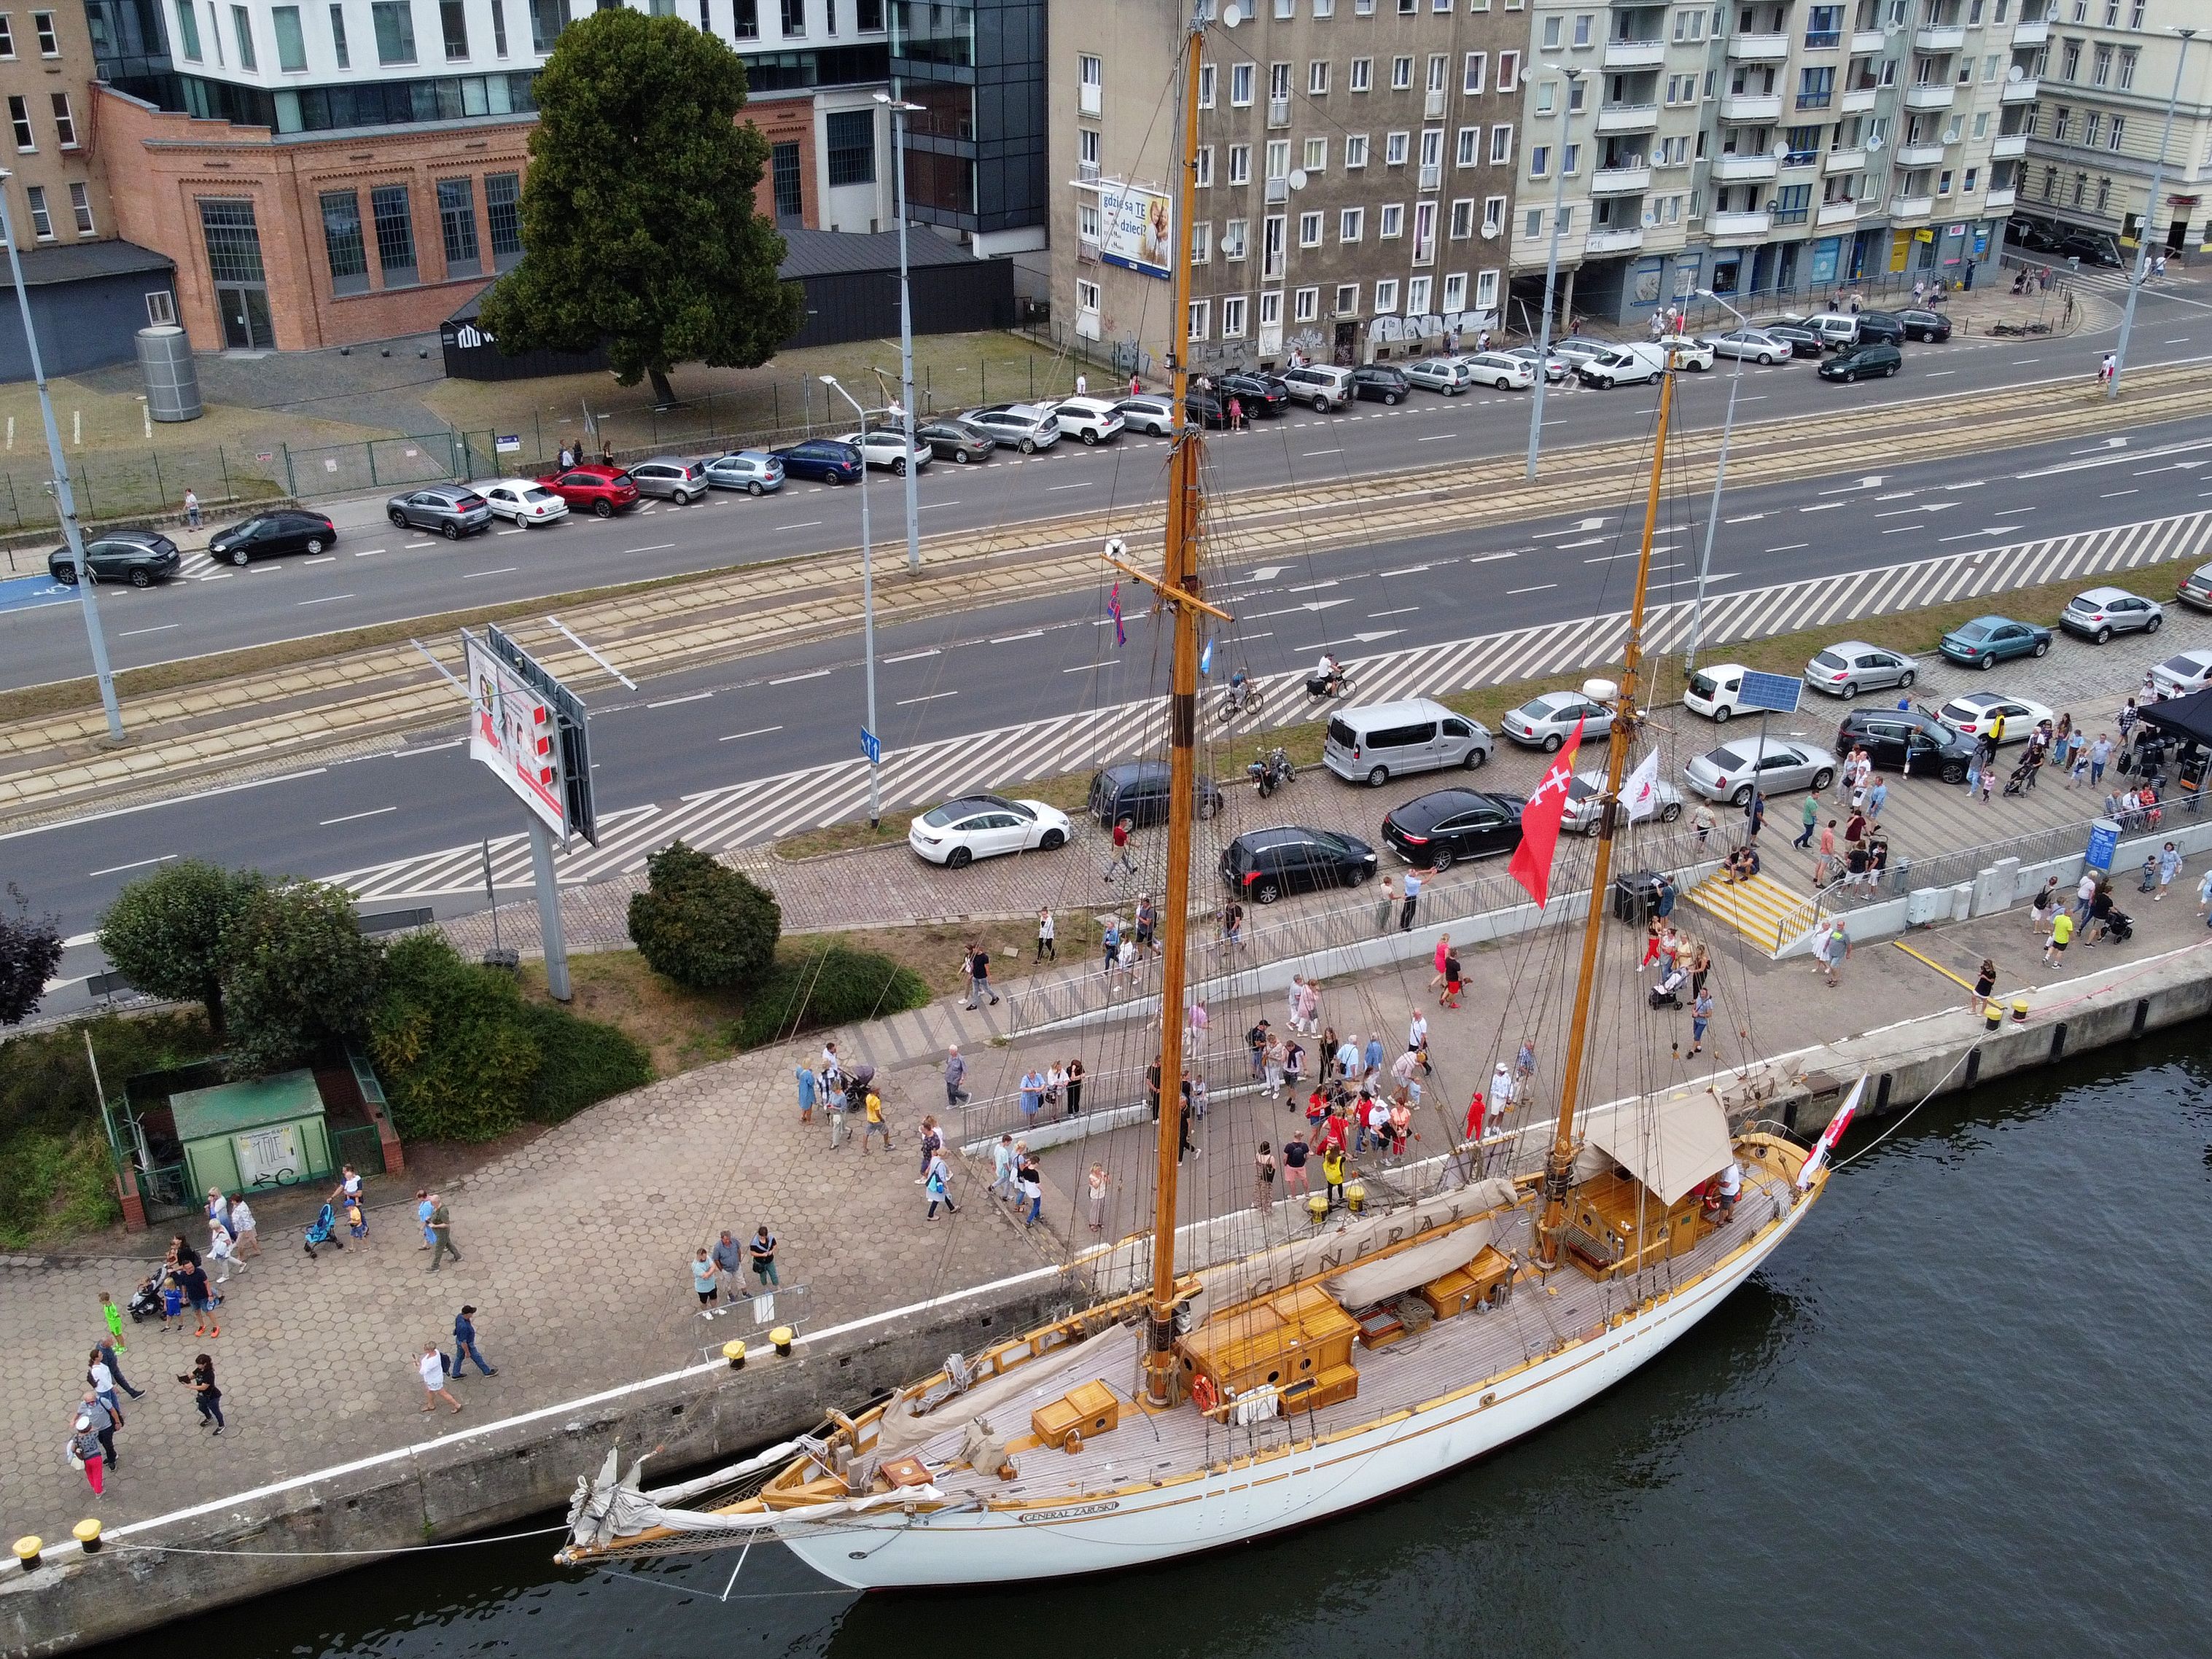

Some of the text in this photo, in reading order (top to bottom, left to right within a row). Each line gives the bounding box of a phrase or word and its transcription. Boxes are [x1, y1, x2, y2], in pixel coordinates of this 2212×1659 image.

[1104, 194, 1146, 216] gdzie są TE
[1121, 219, 1147, 237] dzieci?
[1074, 1502, 1116, 1515] ZARUSKI
